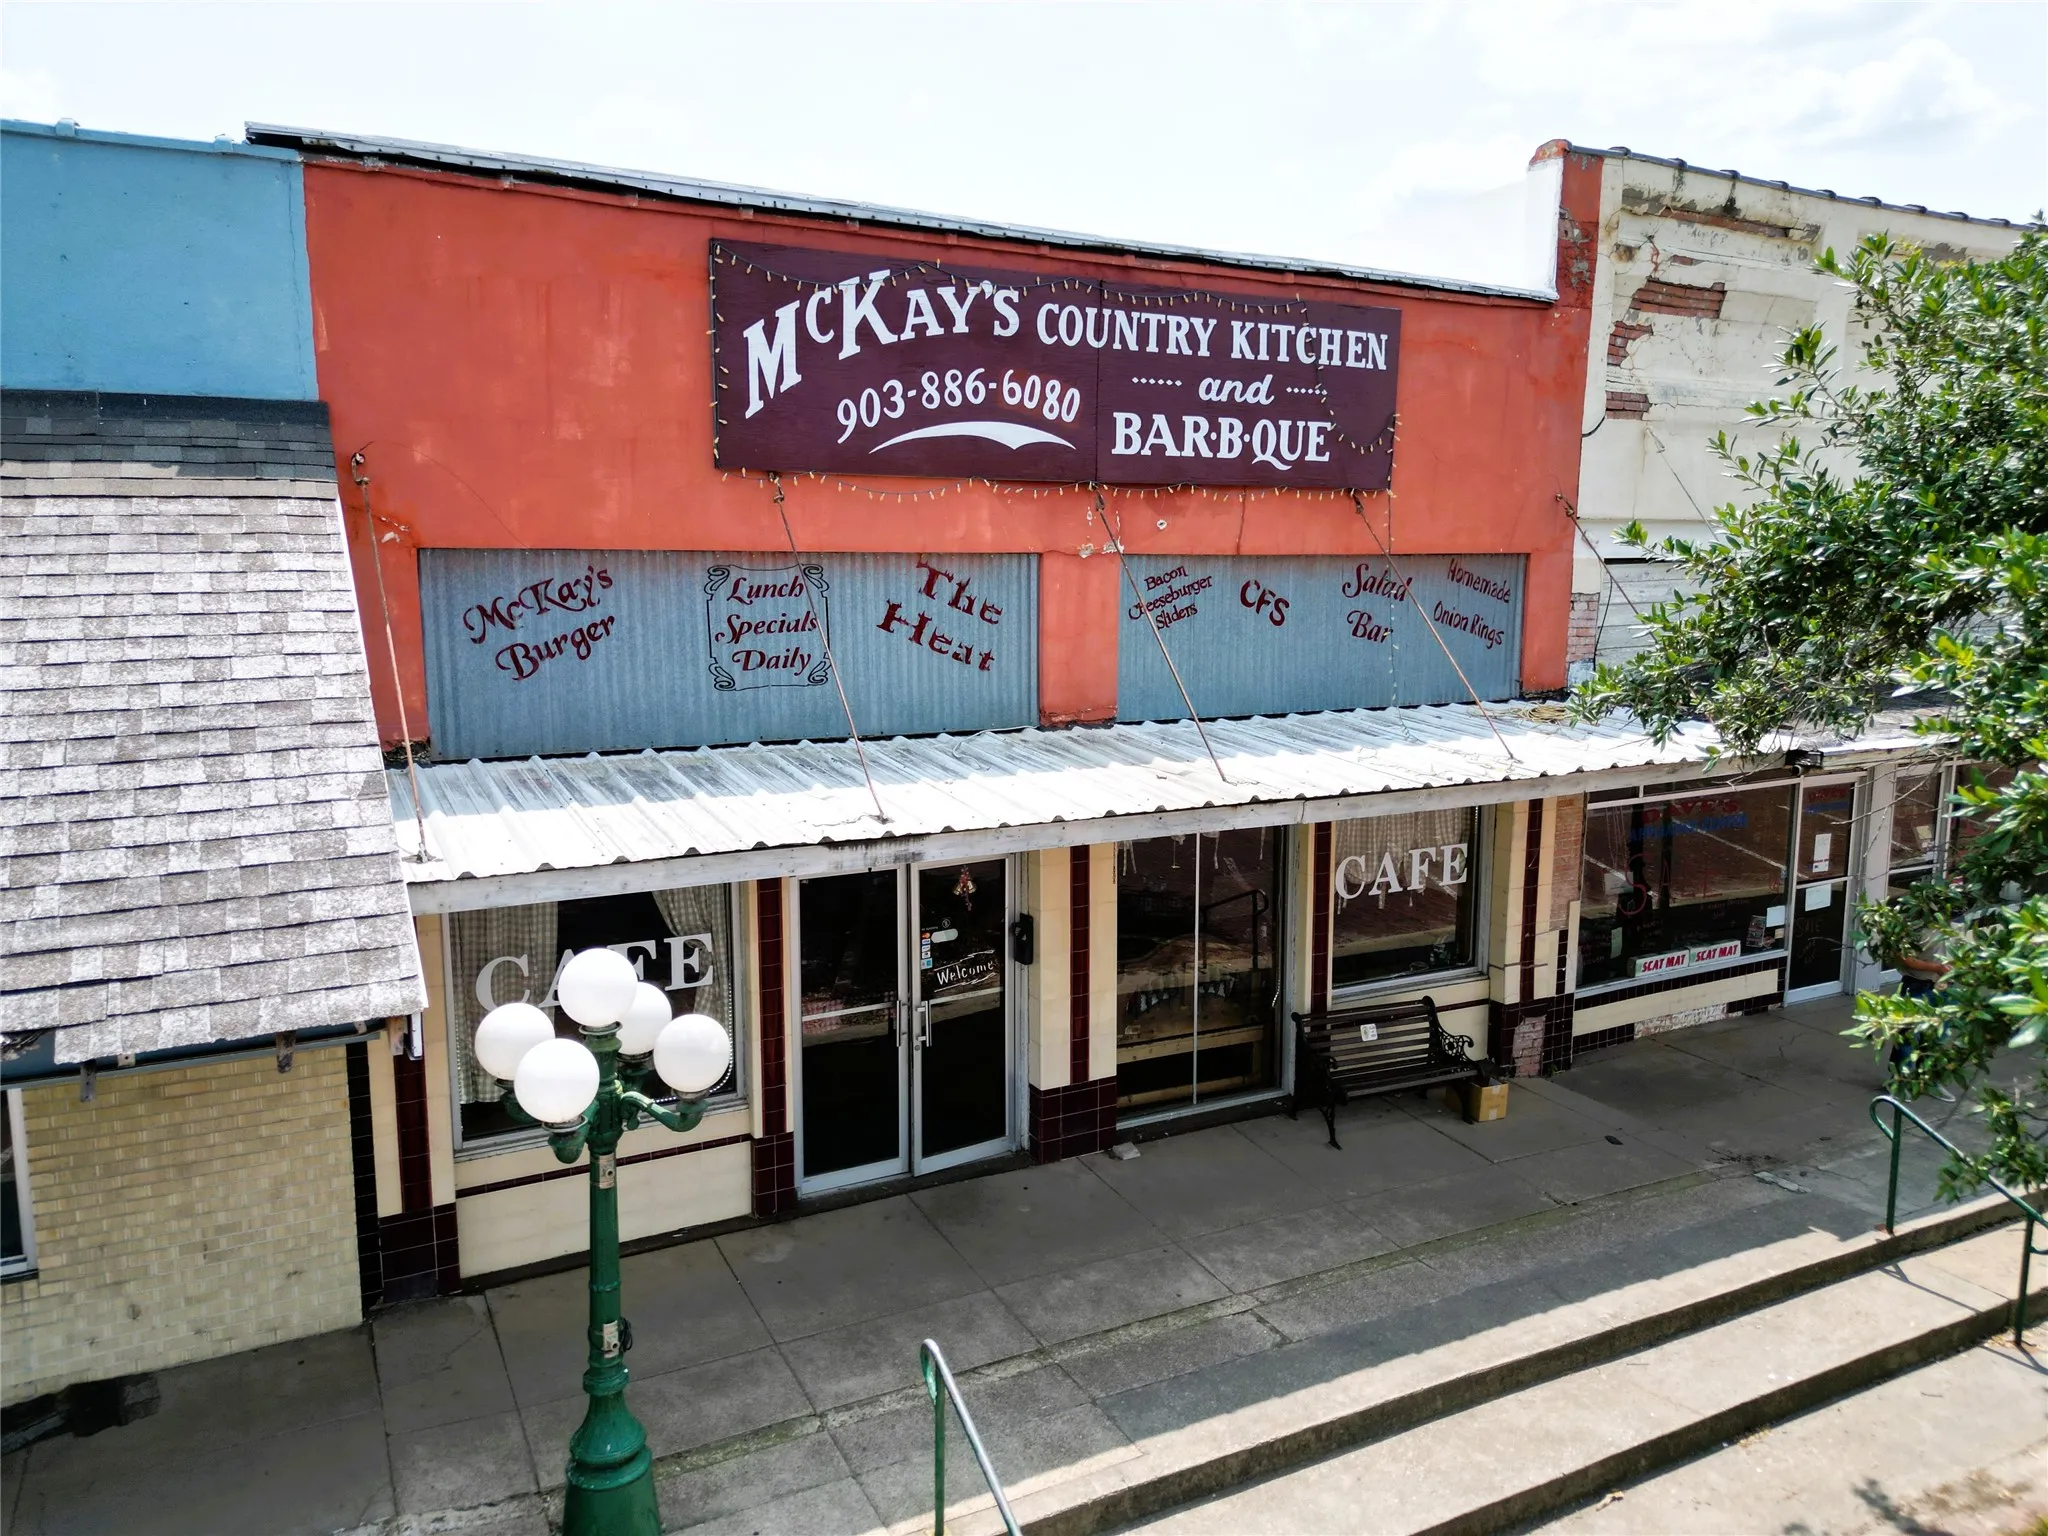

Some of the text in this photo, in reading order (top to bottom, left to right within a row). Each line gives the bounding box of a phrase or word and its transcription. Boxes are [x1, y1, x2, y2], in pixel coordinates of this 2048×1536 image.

[1036, 302, 1388, 370] COUNTRY KITCHEN
[836, 367, 1081, 444] 903-886-6080
[1198, 374, 1275, 405] and
[727, 576, 805, 604] Lunch
[916, 557, 1003, 625] The
[1144, 566, 1188, 591] Bacon
[1342, 563, 1413, 602] Salad
[1446, 558, 1511, 605] Homemade
[1155, 603, 1198, 630] Sliders
[1240, 580, 1289, 626] CFS
[715, 610, 818, 644] Specials
[876, 598, 996, 671] Heat
[1347, 610, 1393, 643] Bar
[1433, 600, 1504, 649] Onion Rings
[495, 613, 616, 681] Burger
[731, 648, 812, 676] Daily
[1336, 843, 1468, 900] CAFE
[1642, 955, 1686, 973] SCAT MAT
[1696, 944, 1739, 962] SCAT MAT
[937, 961, 994, 986] Welcome
